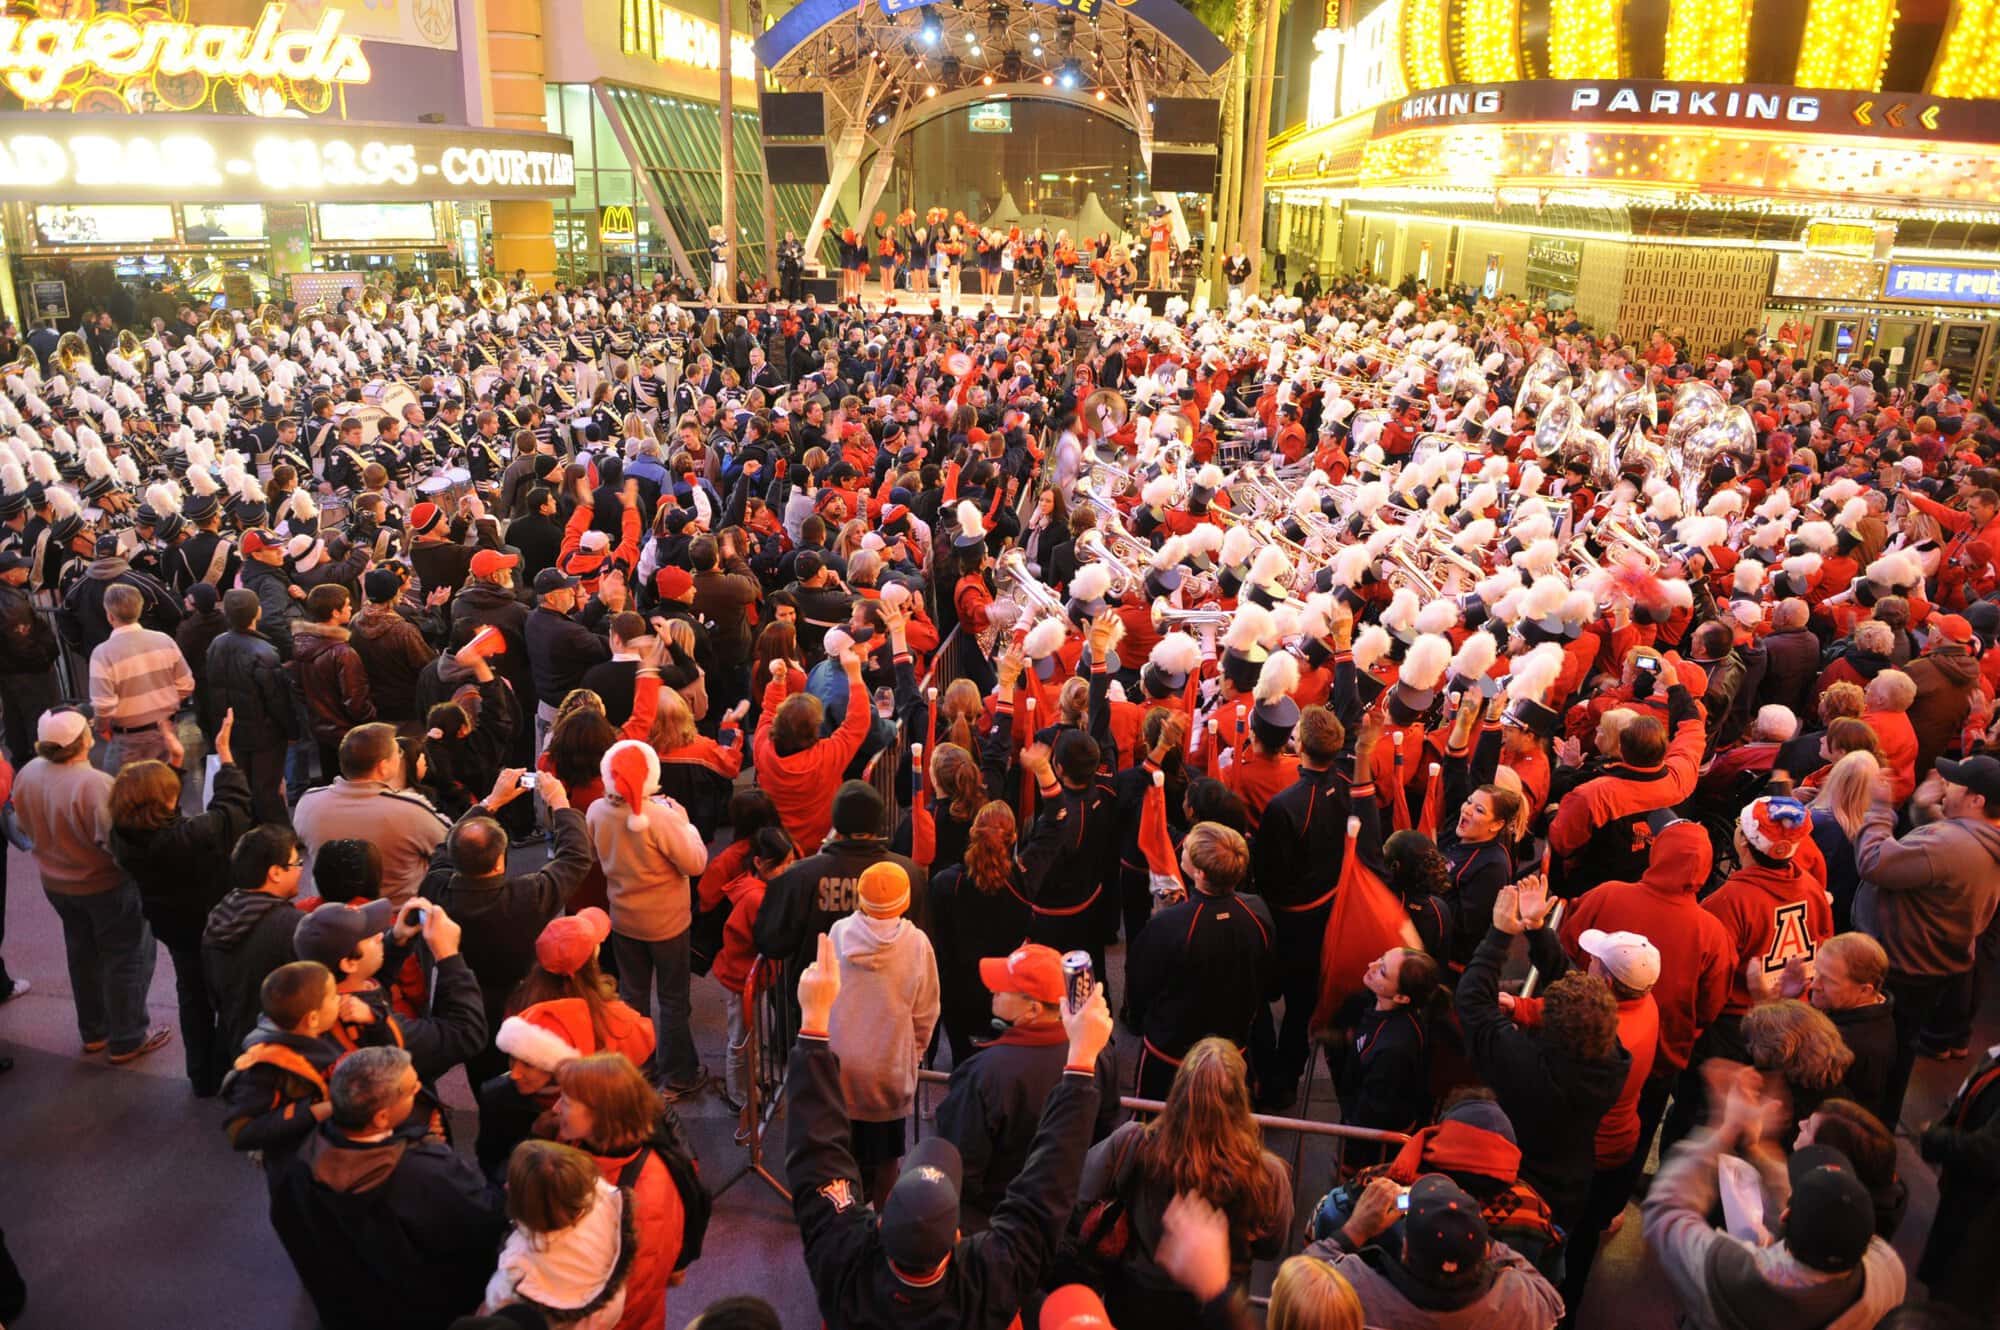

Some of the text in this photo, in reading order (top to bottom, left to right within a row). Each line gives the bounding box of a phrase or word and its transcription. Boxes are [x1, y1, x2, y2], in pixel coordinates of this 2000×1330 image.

[1572, 88, 1820, 122] PARKING
[1895, 271, 1953, 292] FREE
[1762, 901, 1817, 974] A
